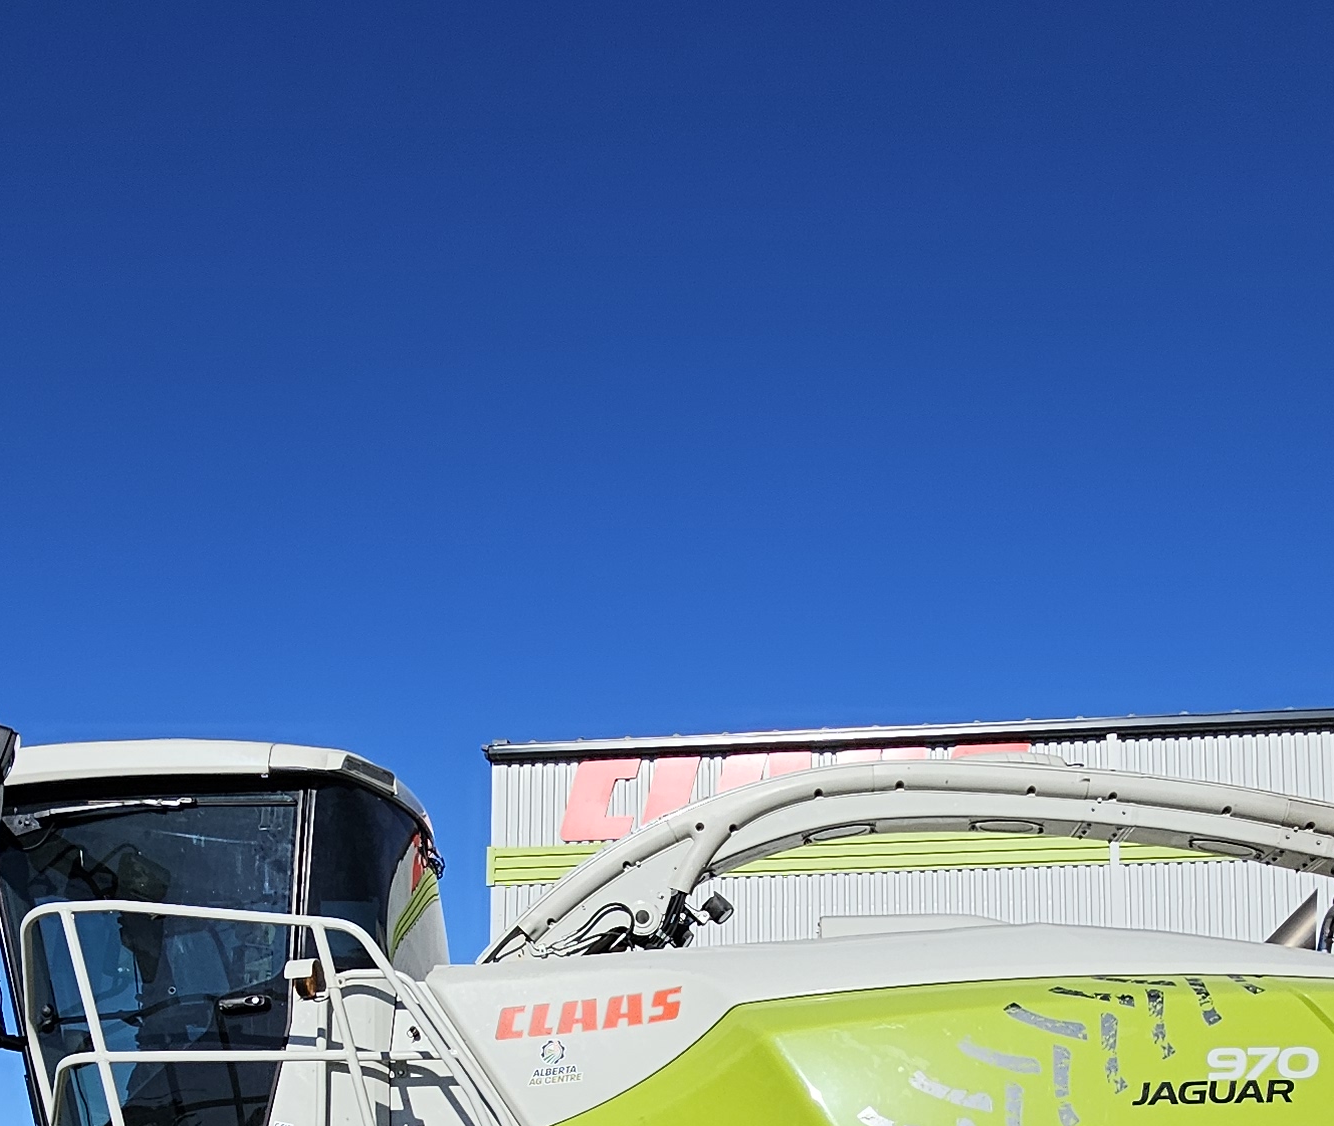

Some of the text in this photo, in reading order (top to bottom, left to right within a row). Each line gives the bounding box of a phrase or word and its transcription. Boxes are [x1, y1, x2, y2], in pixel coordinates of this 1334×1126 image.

[495, 986, 682, 1040] CLAAS
[533, 1065, 577, 1078] ALBERTA
[1207, 1047, 1319, 1081] 970
[529, 1073, 582, 1086] AG CENTRE
[1132, 1080, 1295, 1106] JAGUAR
